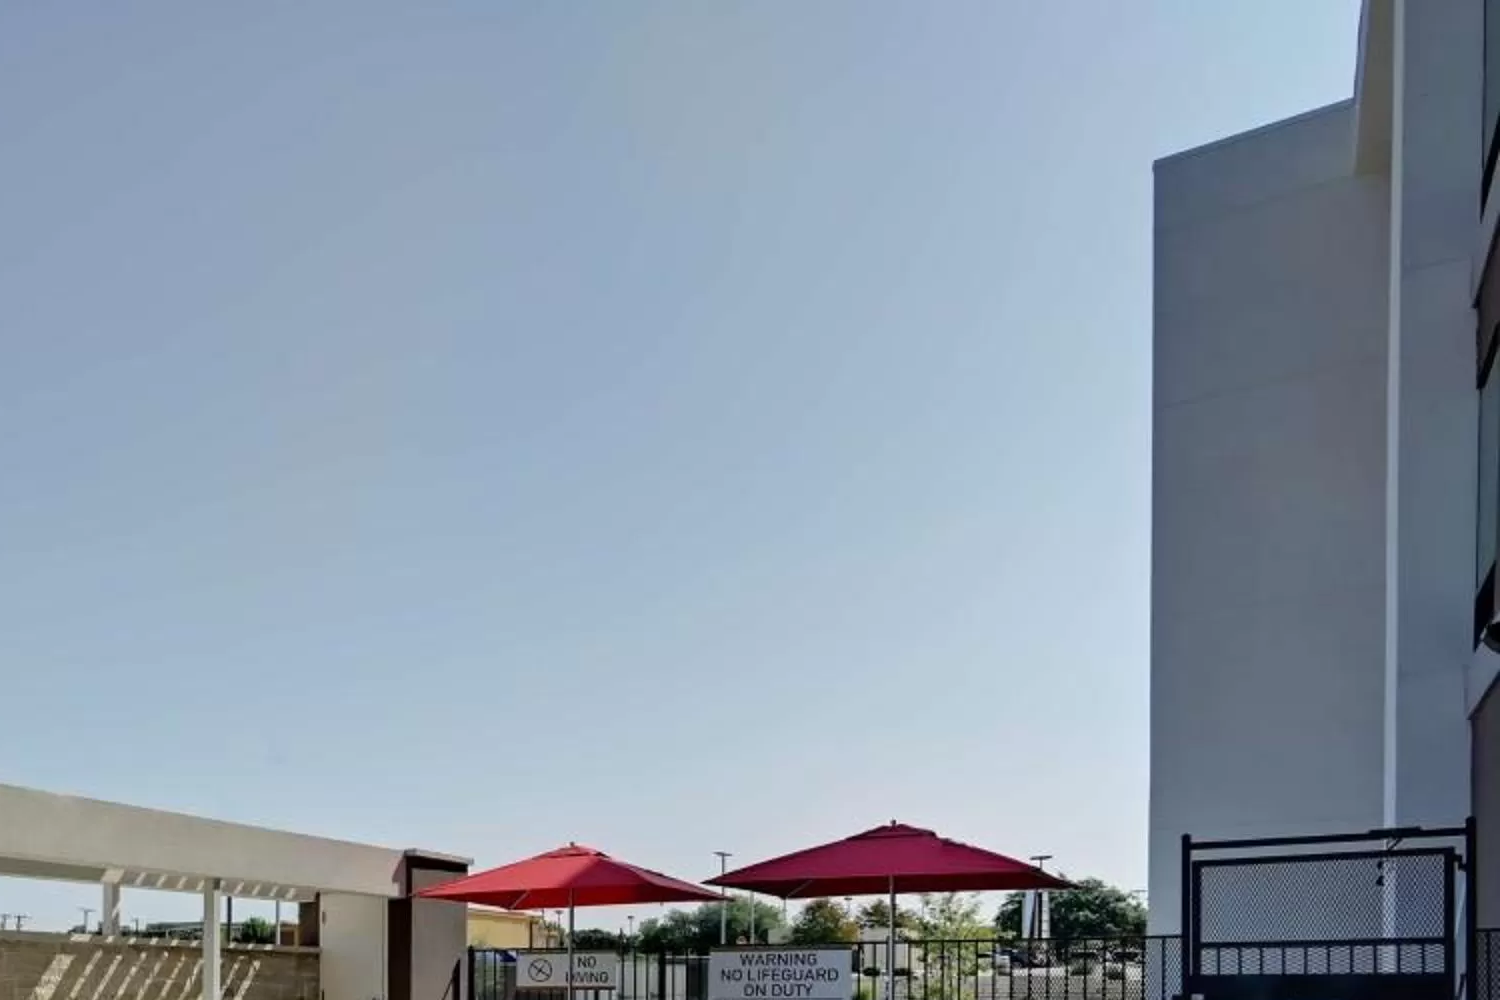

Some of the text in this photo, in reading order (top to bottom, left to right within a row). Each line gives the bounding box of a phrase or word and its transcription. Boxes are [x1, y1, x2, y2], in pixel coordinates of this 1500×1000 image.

[577, 955, 597, 968] NO
[739, 953, 818, 967] WARNING
[720, 968, 840, 982] NO LIFEGUARD
[743, 983, 814, 997] ON DUTY
